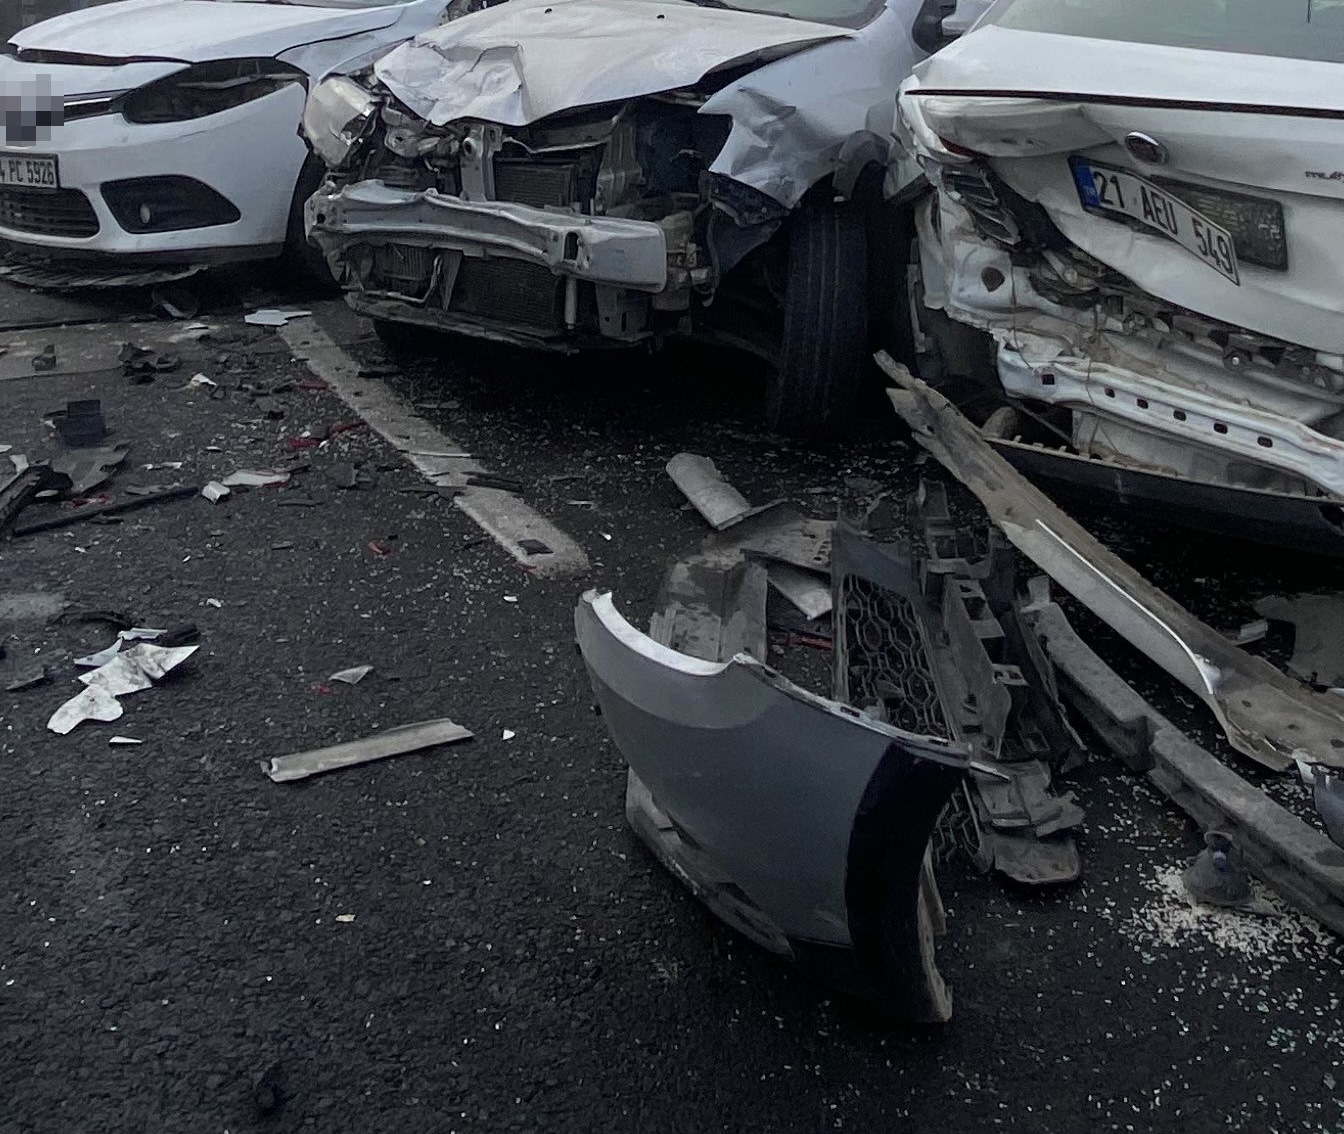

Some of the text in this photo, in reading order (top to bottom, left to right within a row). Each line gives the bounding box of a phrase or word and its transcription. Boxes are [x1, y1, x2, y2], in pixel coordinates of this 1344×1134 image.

[8, 159, 24, 183] PC
[26, 160, 55, 185] 5926
[1093, 170, 1234, 275] 21 AEU 549
